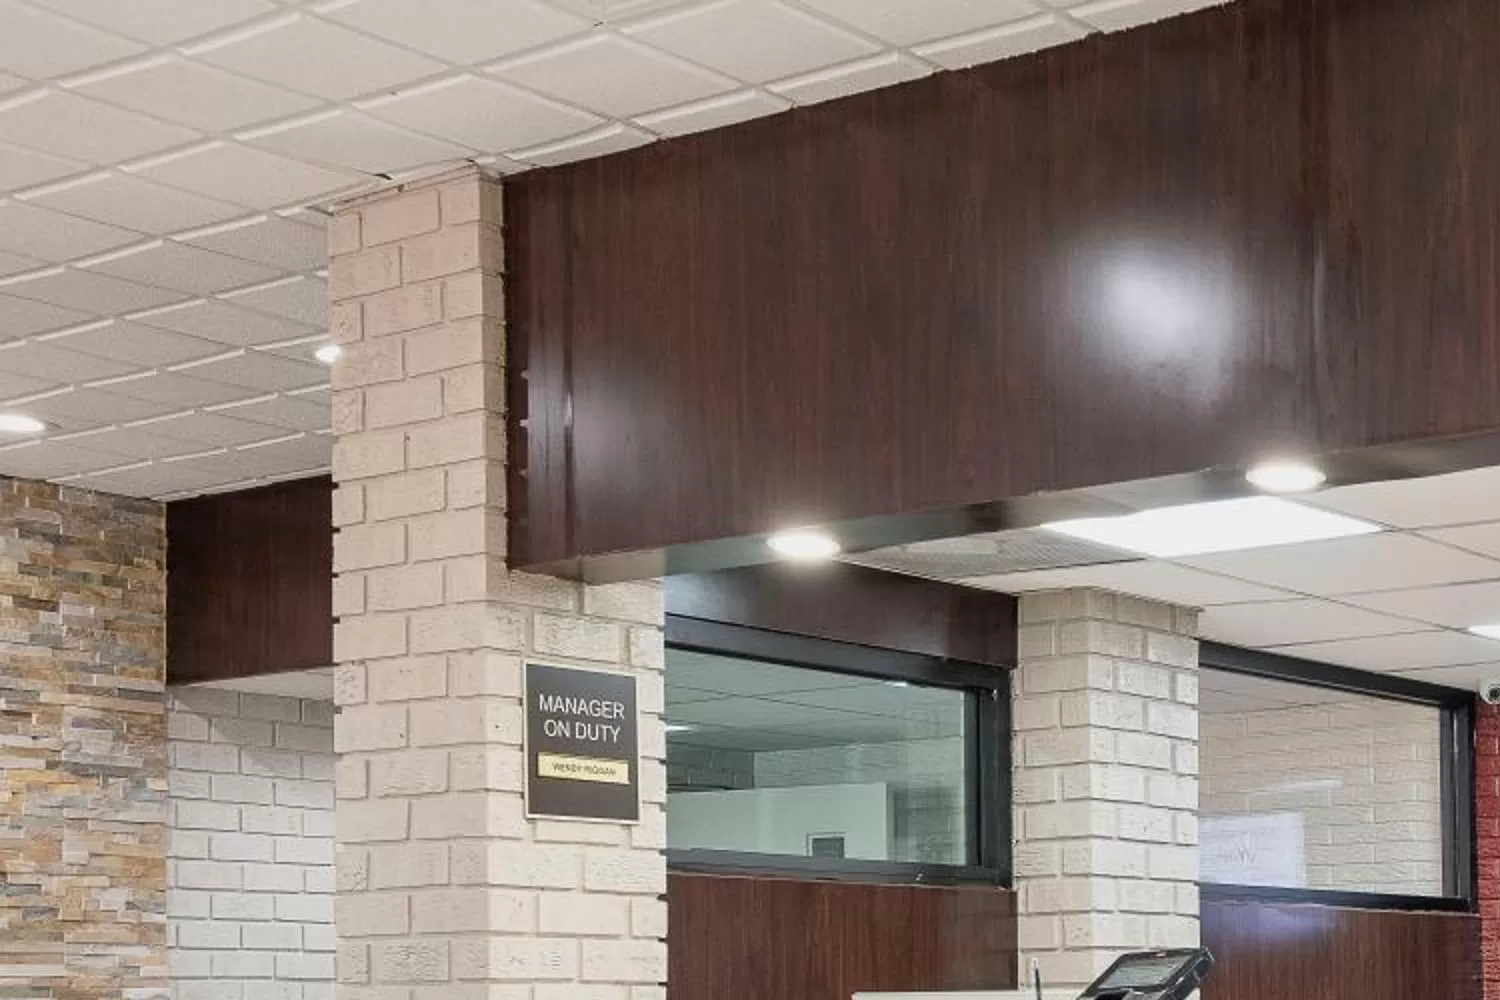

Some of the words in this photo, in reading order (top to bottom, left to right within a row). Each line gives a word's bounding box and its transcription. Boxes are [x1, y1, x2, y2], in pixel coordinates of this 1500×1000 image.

[539, 693, 625, 720] MANAGER
[543, 719, 571, 738] ON
[575, 722, 621, 744] DUTY
